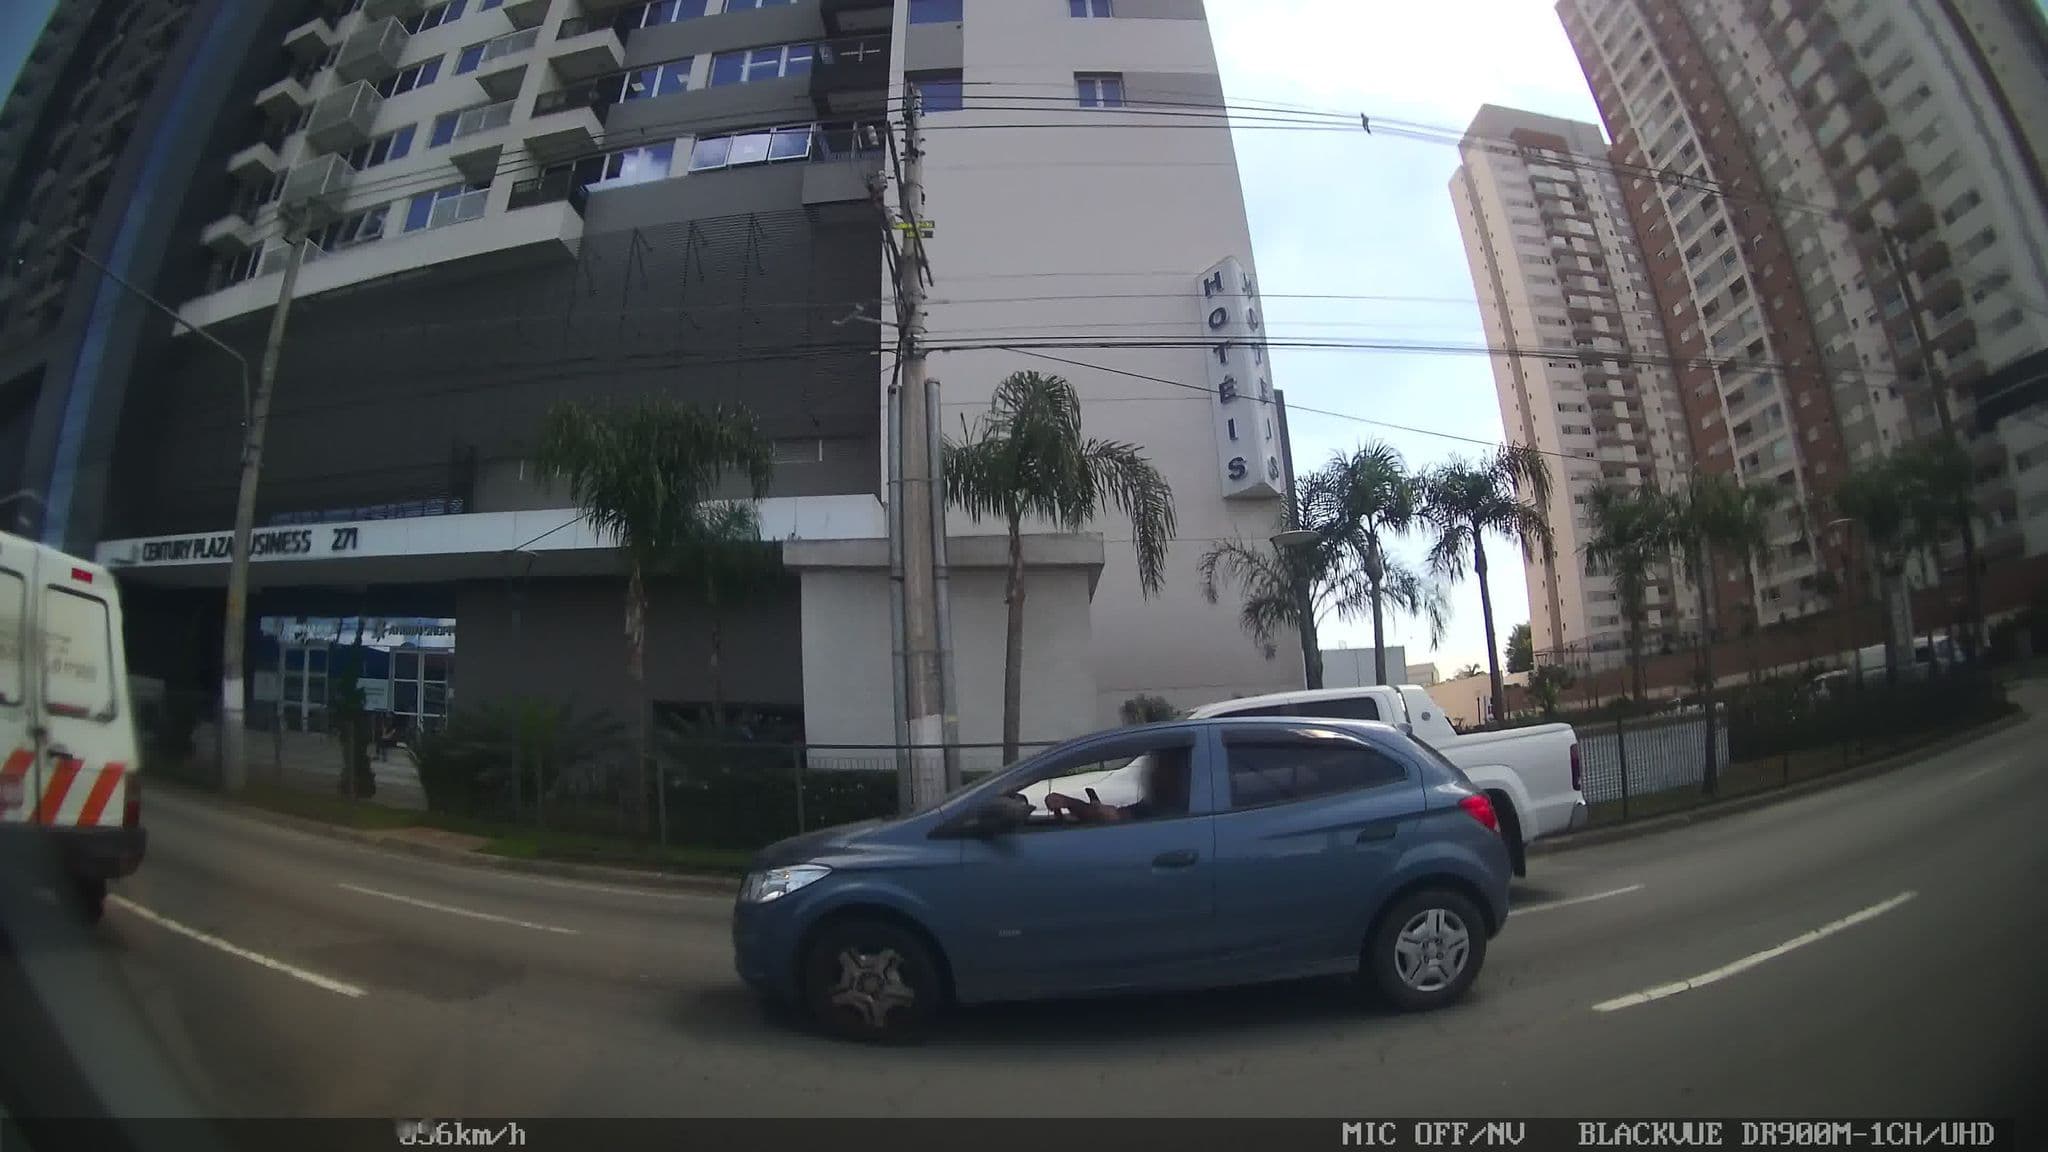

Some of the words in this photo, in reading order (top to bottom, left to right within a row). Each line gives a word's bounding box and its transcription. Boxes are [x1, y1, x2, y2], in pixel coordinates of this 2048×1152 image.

[1203, 270, 1248, 481] HOTÉIS
[142, 539, 192, 561] CENTURY
[249, 529, 312, 555] USINESS
[331, 527, 358, 551] 271
